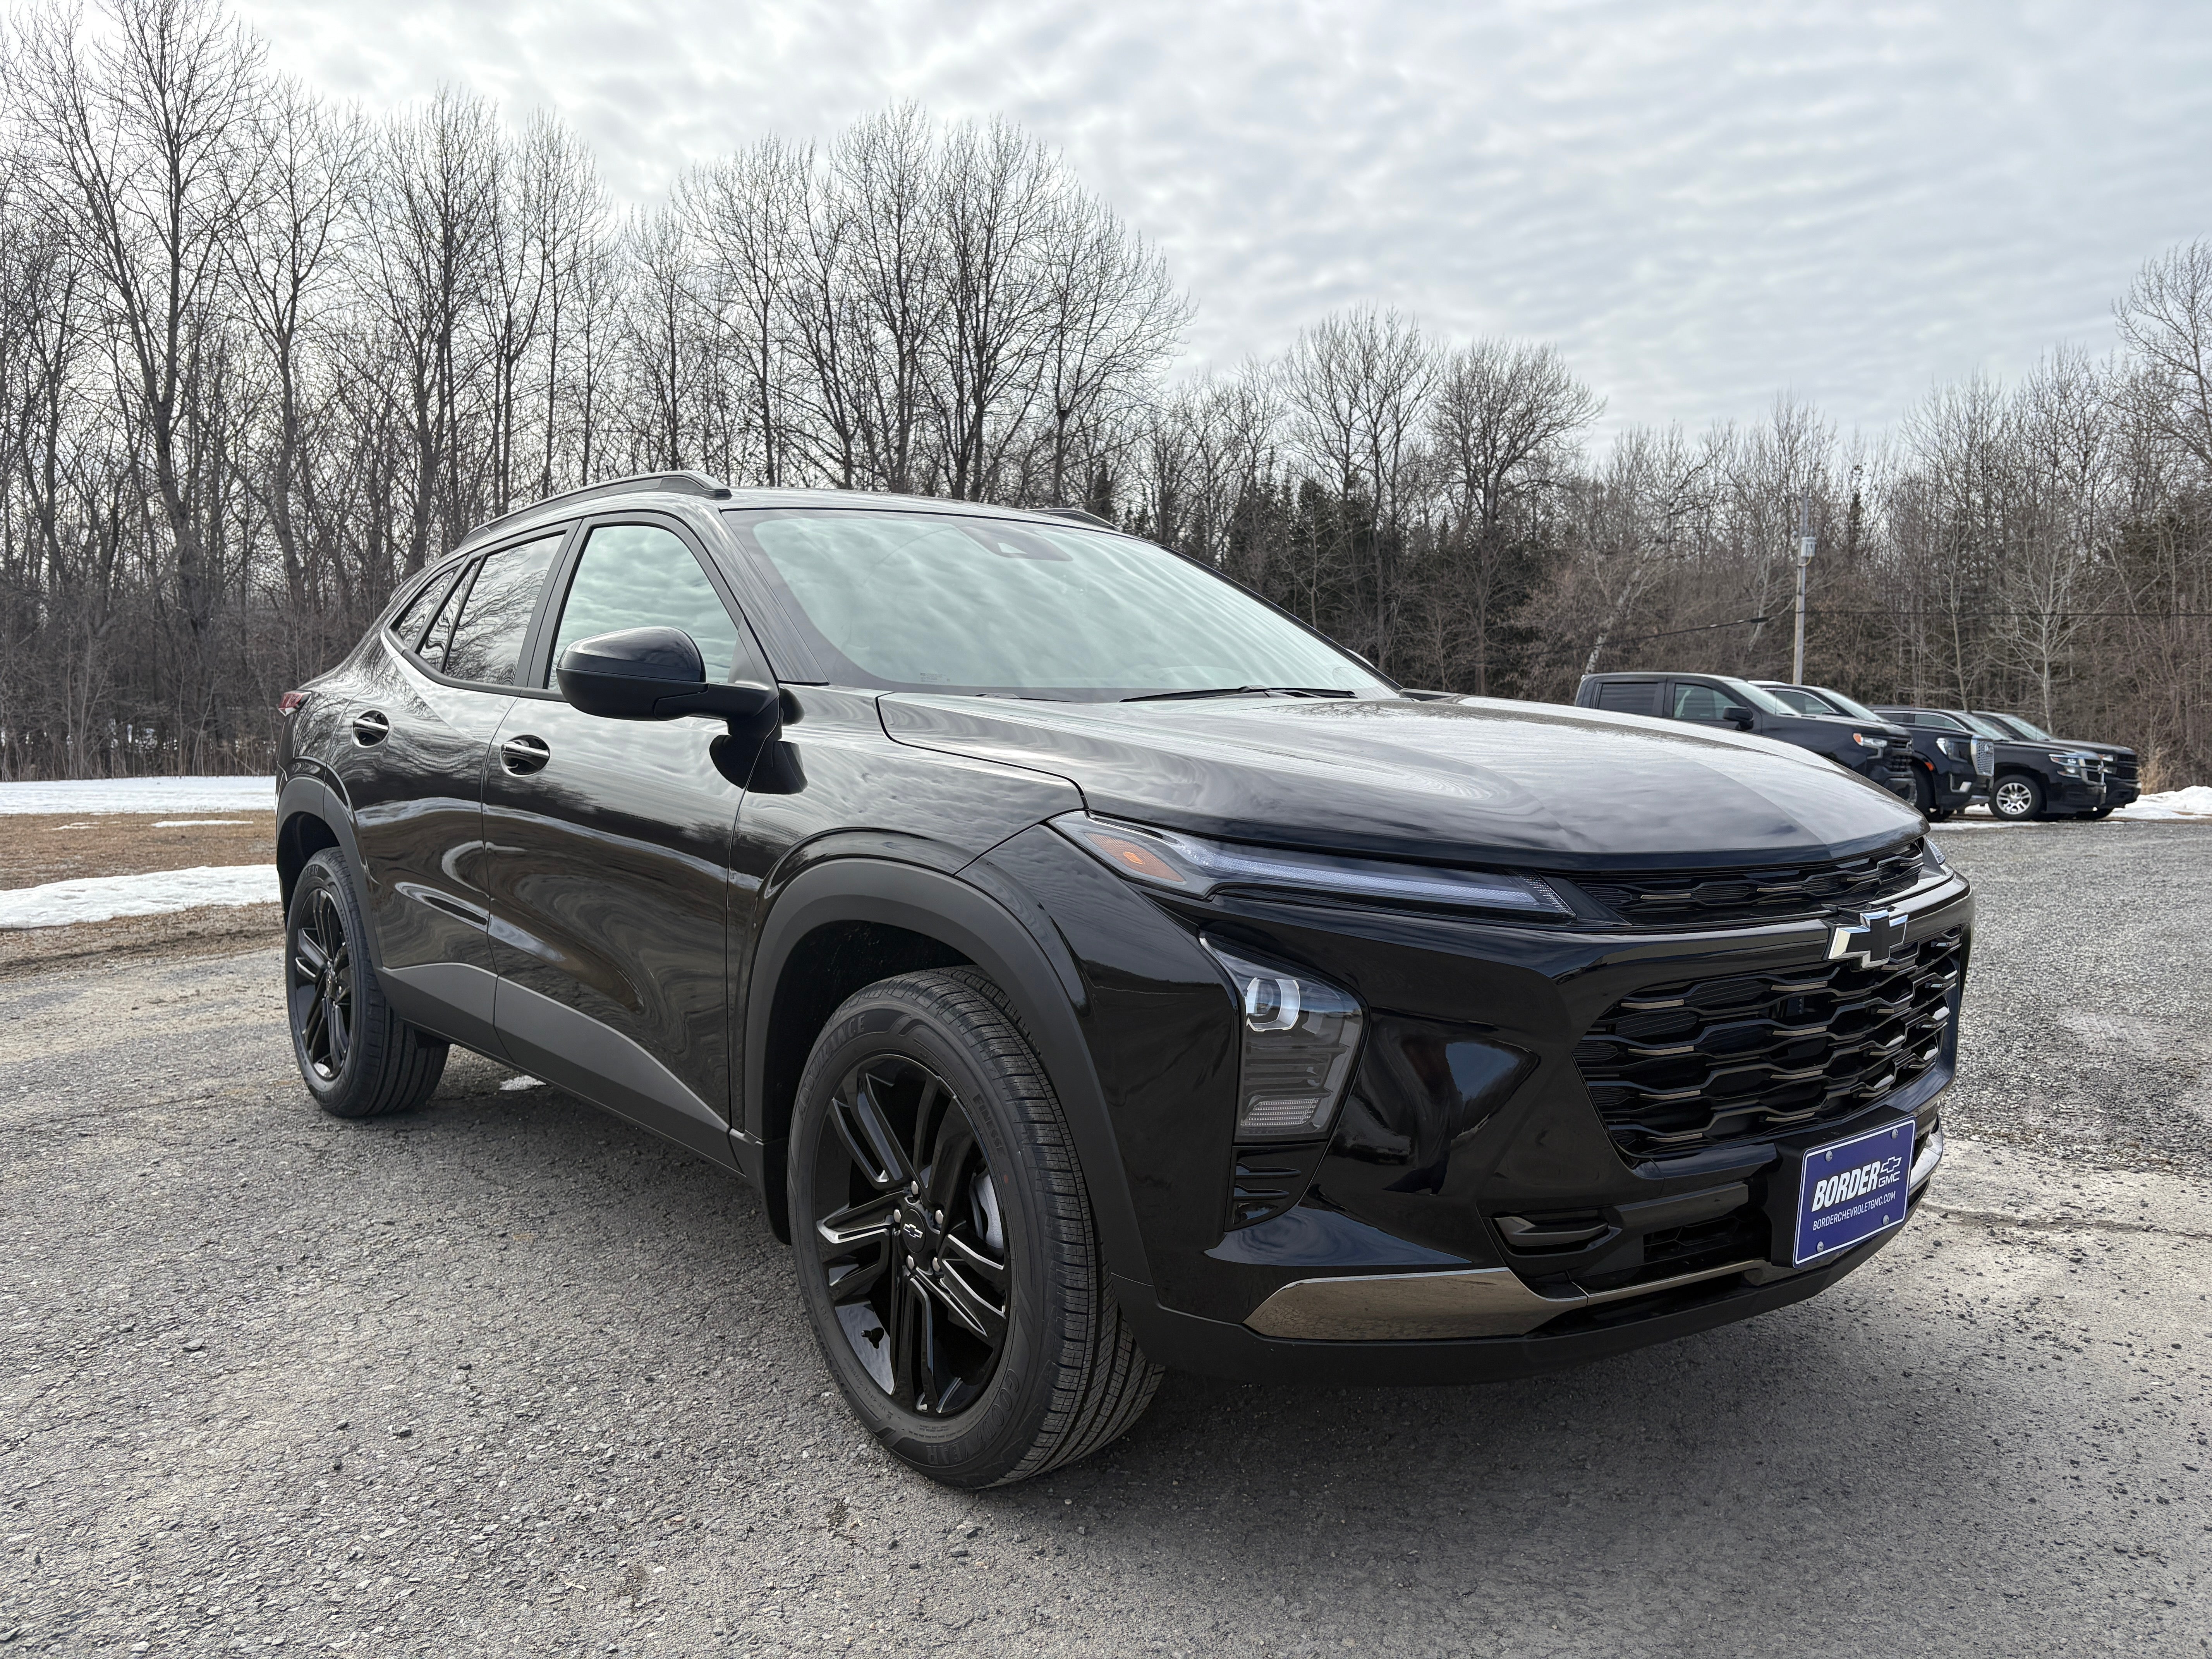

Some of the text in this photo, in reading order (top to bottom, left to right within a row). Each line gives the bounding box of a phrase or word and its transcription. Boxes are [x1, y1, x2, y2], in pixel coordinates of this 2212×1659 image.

[1812, 1161, 1881, 1212] BORDER
[1878, 1171, 1901, 1188] GMC
[1813, 1190, 1896, 1231] BORDERCHEVROLETGMC.COM
[926, 1369, 1020, 1465] GOODYEAR
